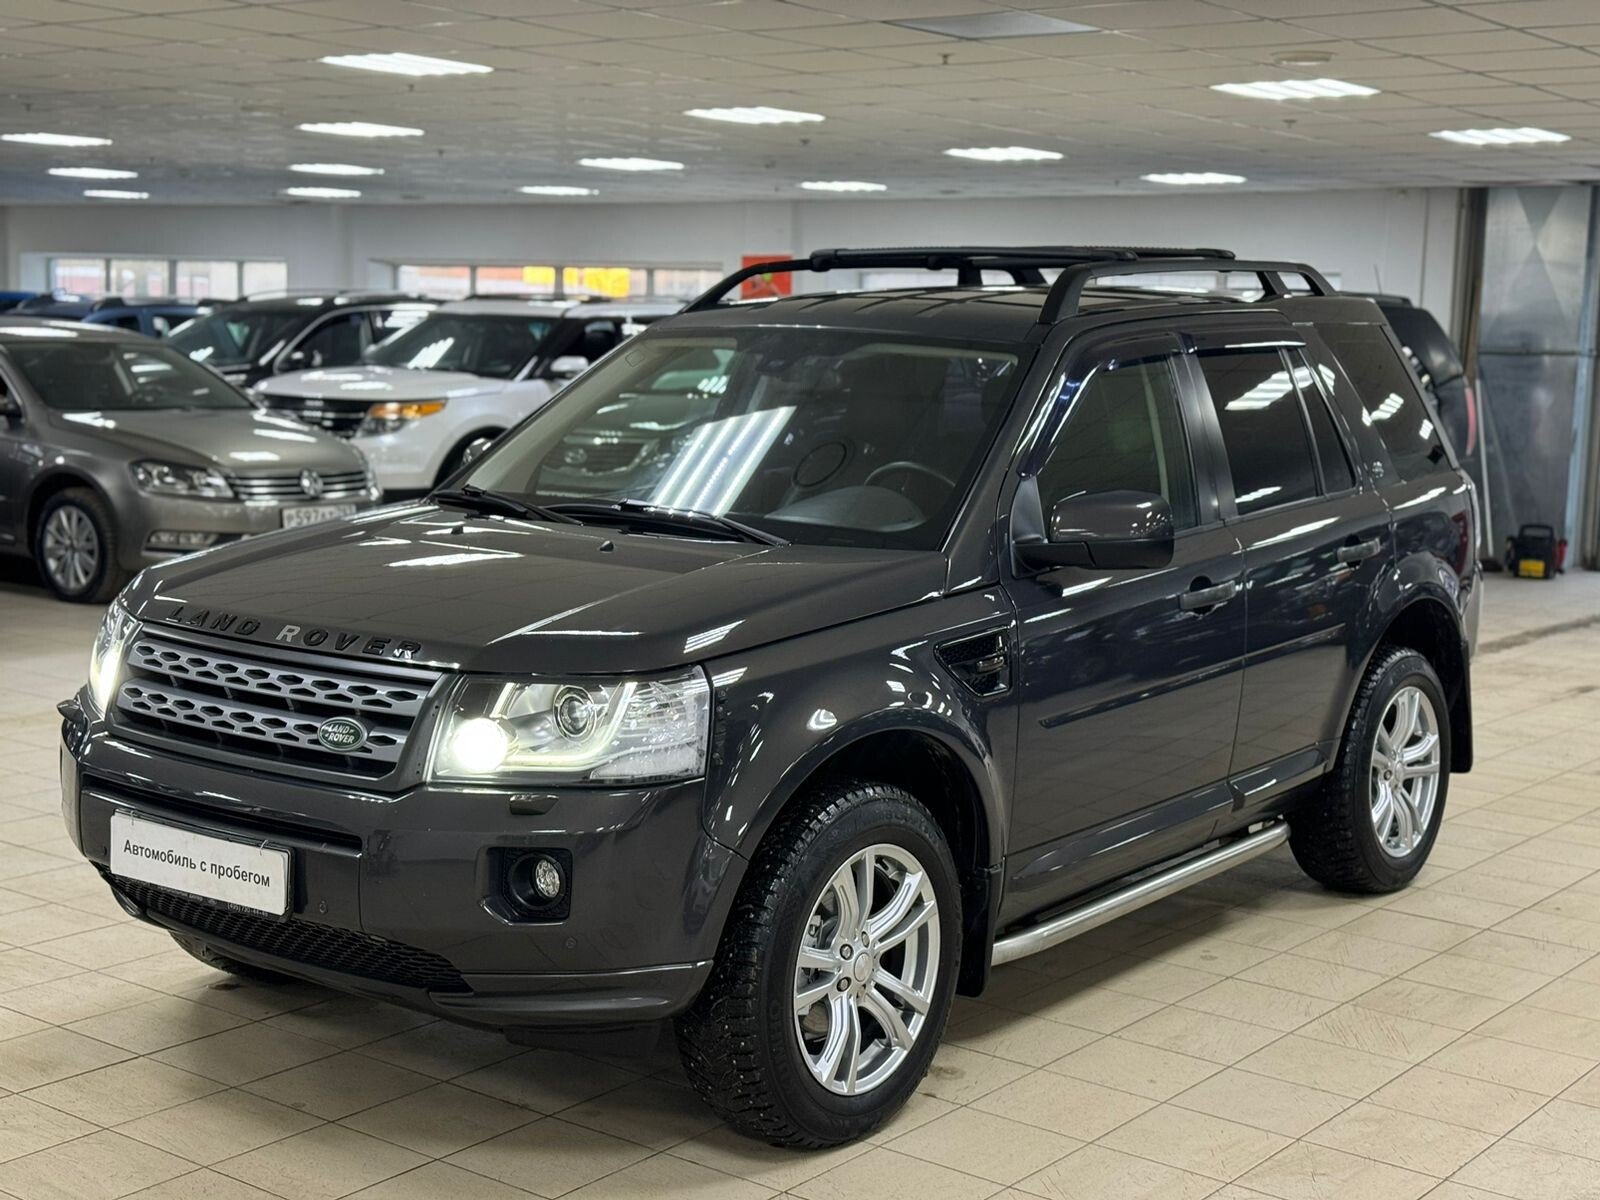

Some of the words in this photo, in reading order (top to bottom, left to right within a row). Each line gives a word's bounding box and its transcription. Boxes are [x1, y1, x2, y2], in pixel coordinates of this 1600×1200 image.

[165, 606, 261, 636] LAND
[275, 624, 422, 660] ROVER
[328, 723, 351, 734] LAND
[328, 732, 355, 744] ROVER
[123, 839, 197, 870] Автомобиль
[199, 860, 207, 872] с
[210, 863, 270, 888] пробегом
